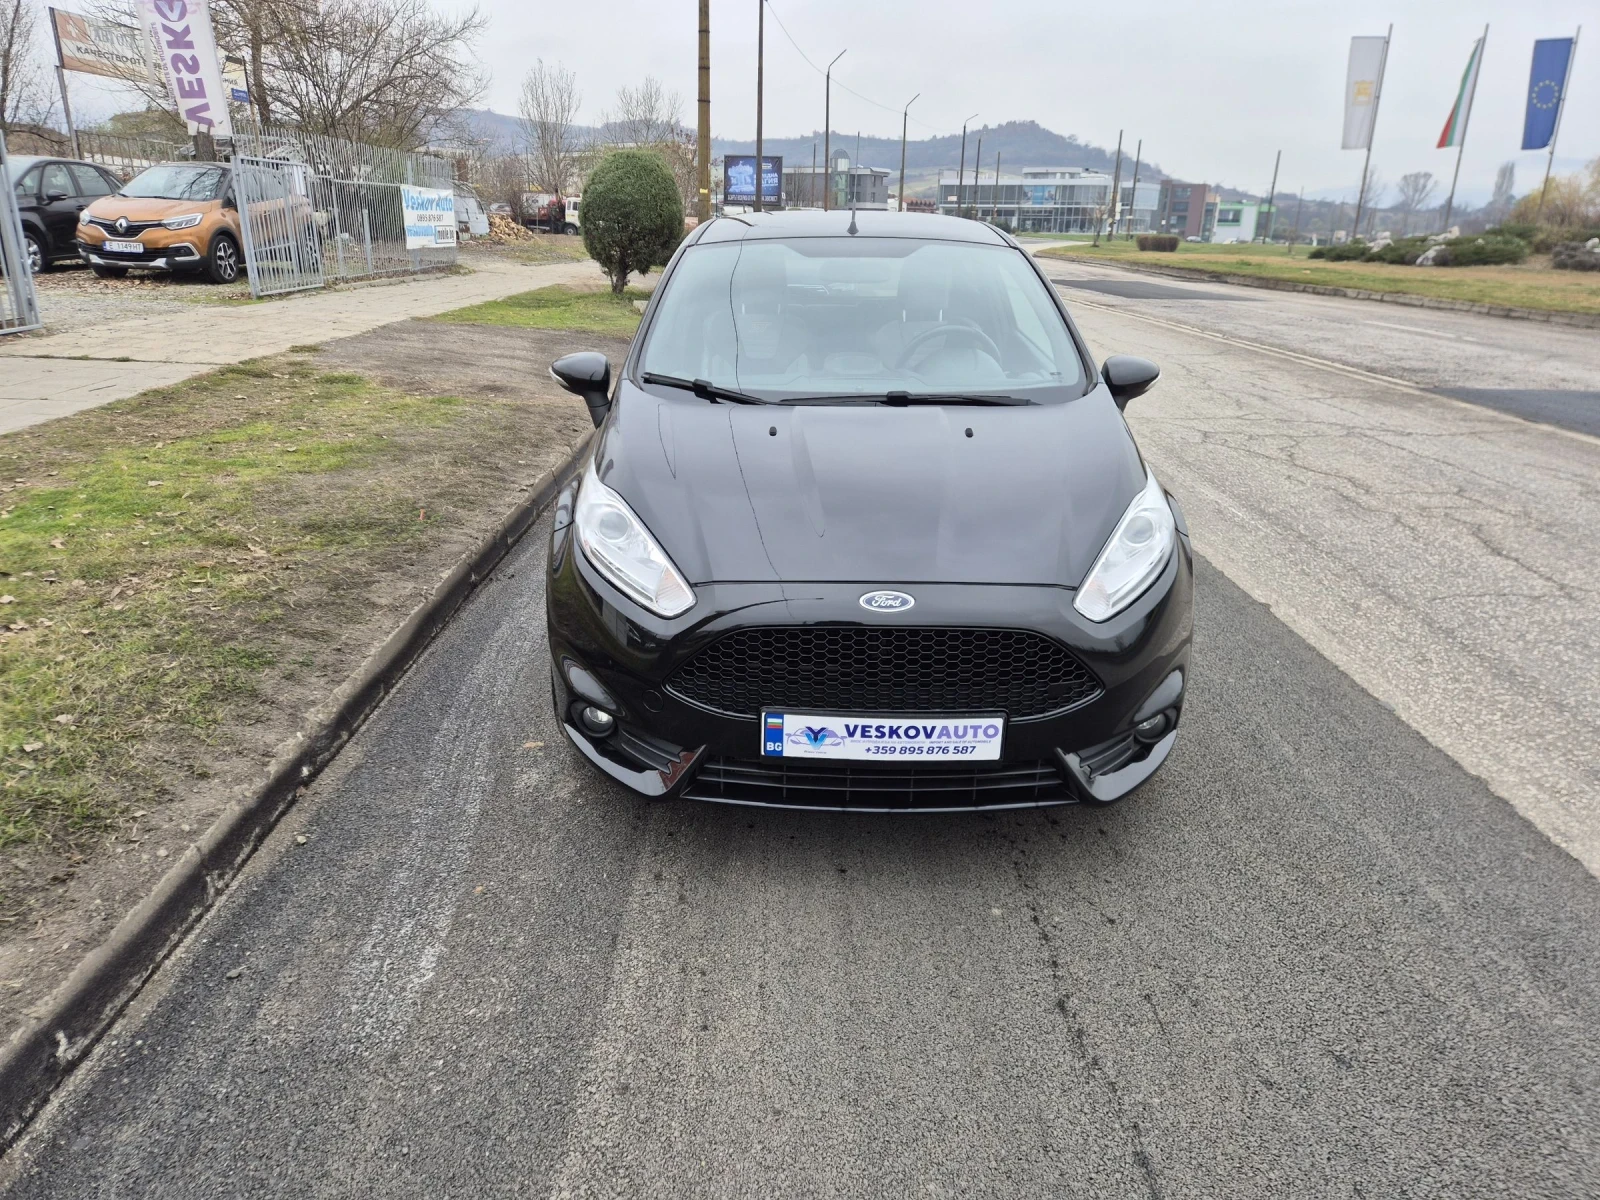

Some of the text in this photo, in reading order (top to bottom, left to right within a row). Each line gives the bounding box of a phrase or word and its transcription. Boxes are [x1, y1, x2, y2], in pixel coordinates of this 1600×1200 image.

[76, 45, 128, 63] КАЧЕСТВО
[403, 188, 453, 212] Veskov Auto
[872, 594, 902, 607] Ford
[844, 723, 1000, 740] VESKOVAUTO
[766, 742, 782, 751] BG
[865, 745, 977, 755] +359 895 876 587
